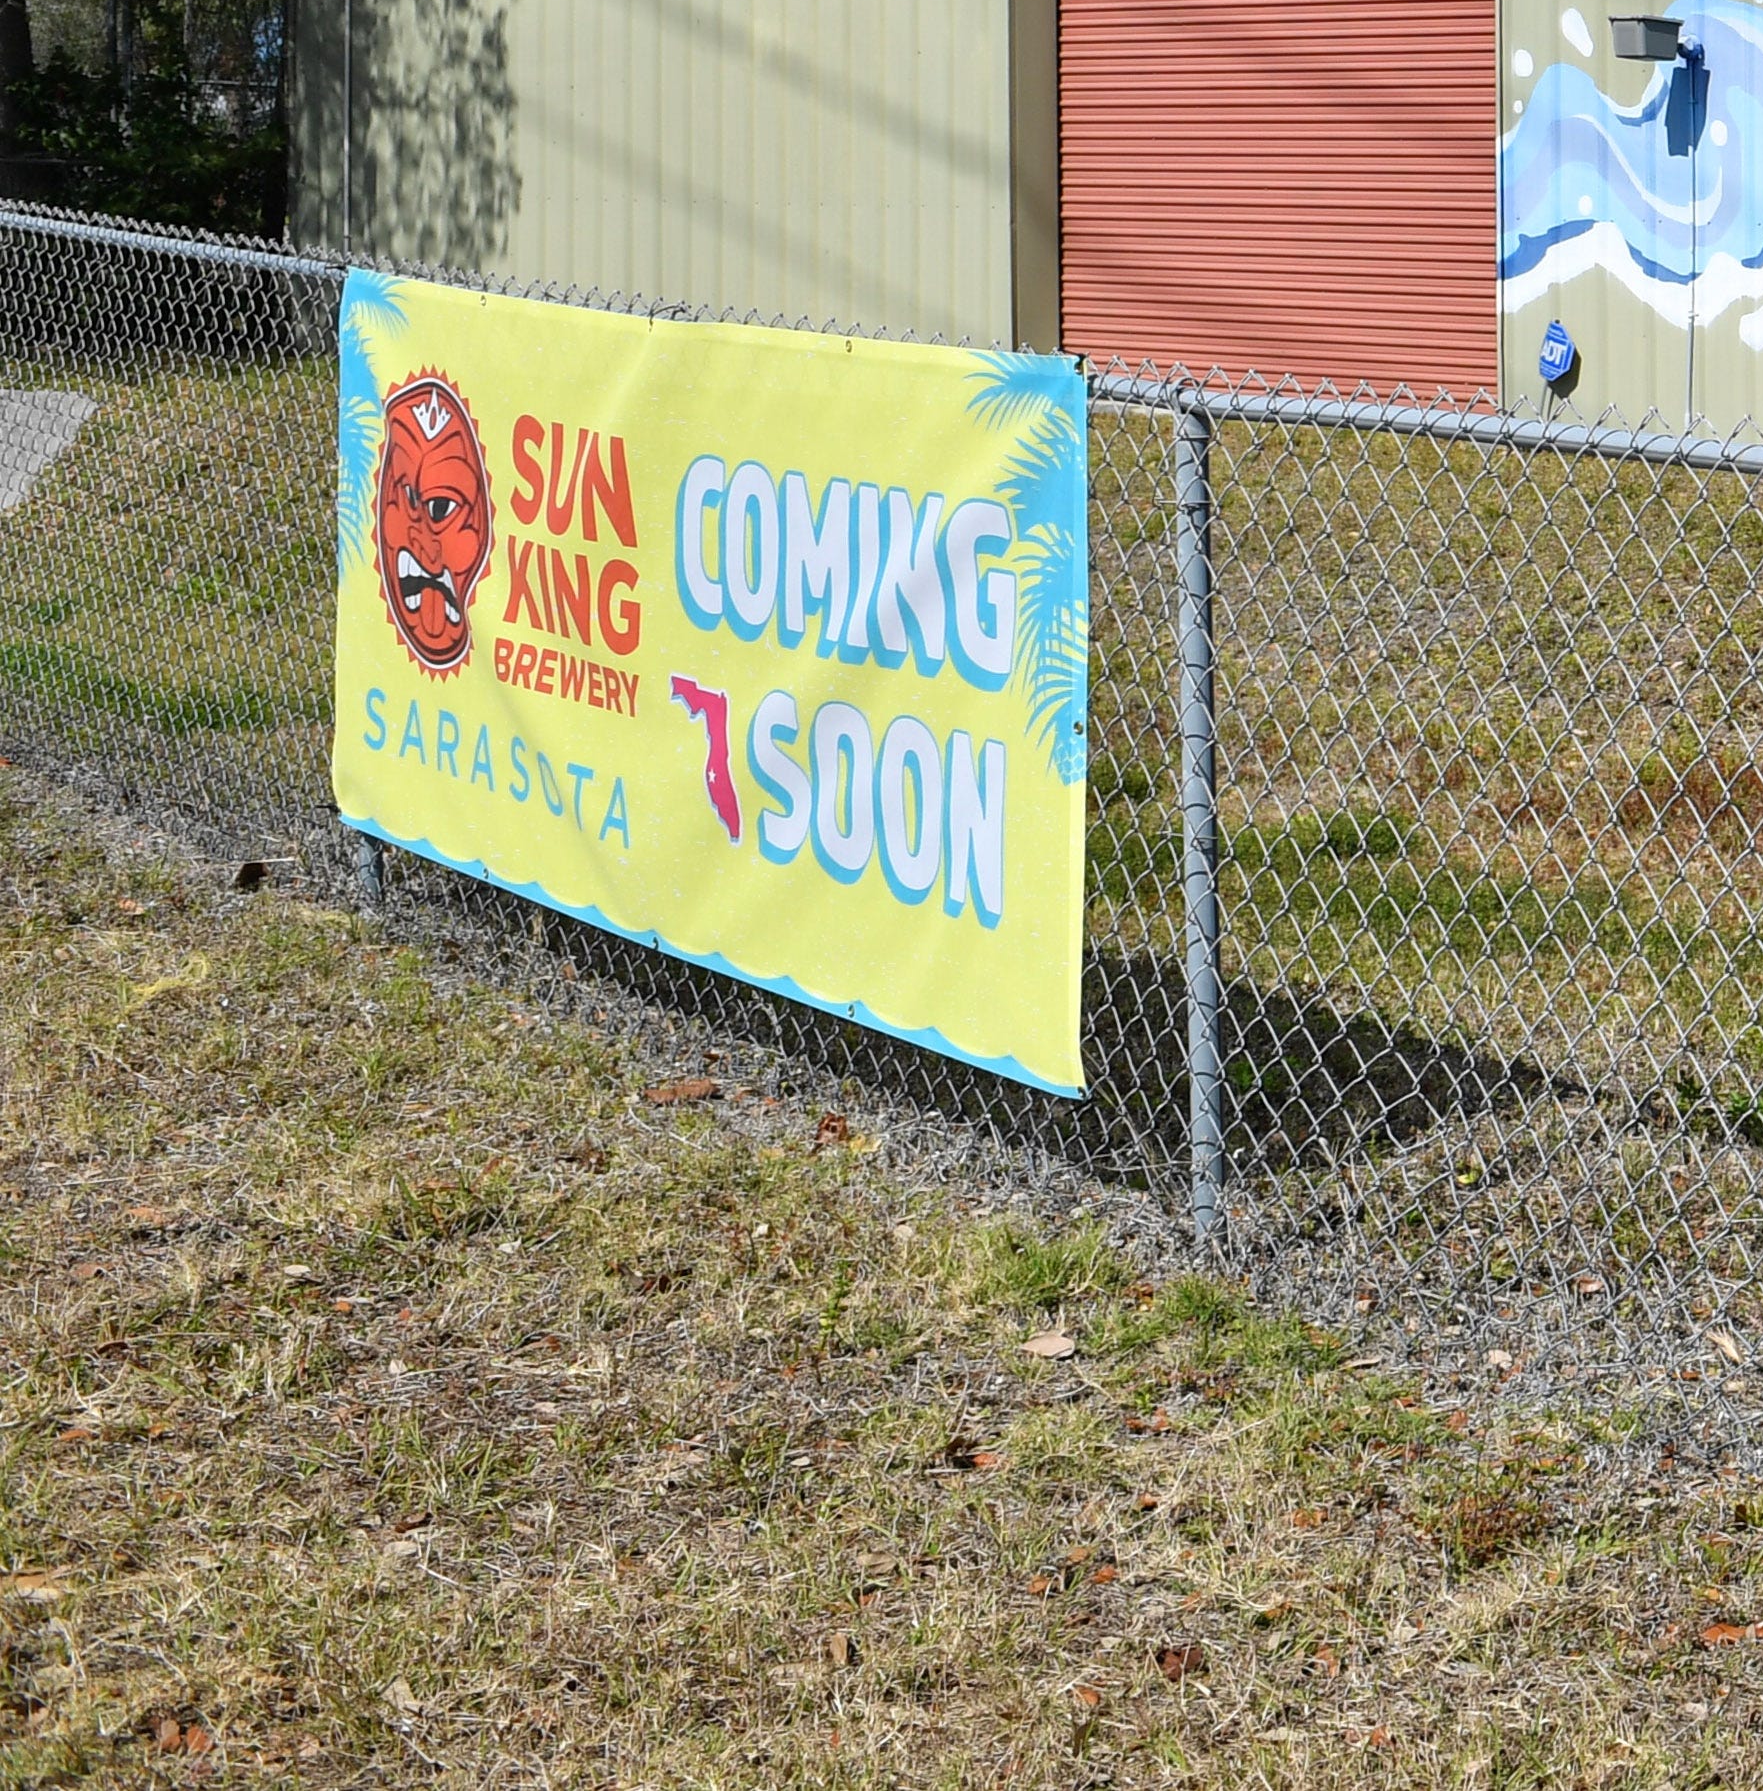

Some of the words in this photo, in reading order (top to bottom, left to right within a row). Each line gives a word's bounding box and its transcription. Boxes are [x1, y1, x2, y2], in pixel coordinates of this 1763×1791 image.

[511, 415, 638, 549] SUN
[503, 536, 642, 656] KING
[675, 454, 1017, 692] COMING
[494, 638, 640, 719] BREWERY
[364, 687, 631, 850] SARASOTA
[748, 689, 1006, 930] SOON
